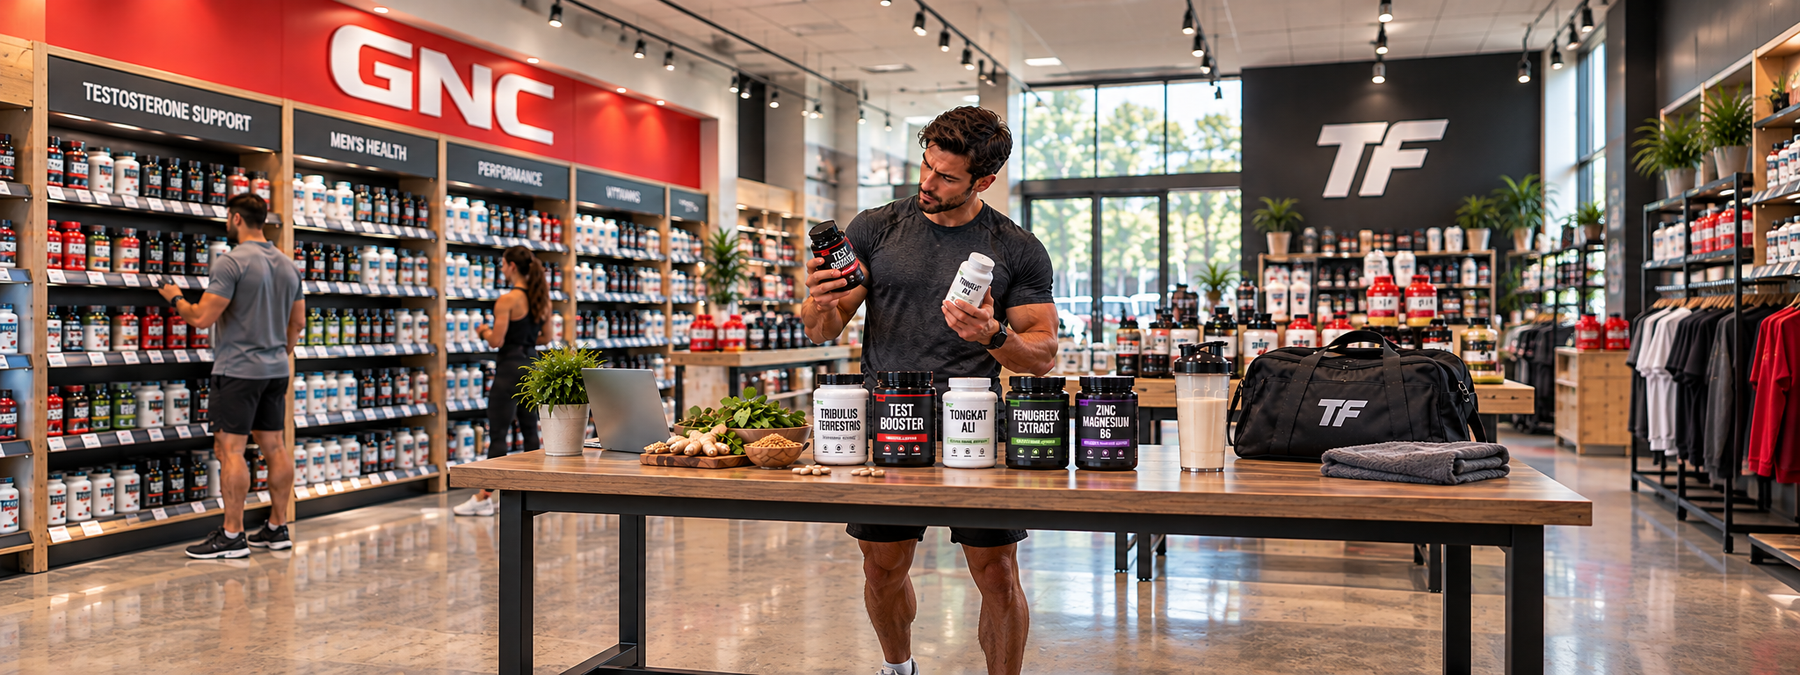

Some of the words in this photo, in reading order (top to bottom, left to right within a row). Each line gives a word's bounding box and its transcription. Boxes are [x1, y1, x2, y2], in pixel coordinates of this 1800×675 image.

[330, 25, 555, 144] GNC
[83, 82, 190, 120] TESTOSTERONE
[192, 105, 252, 132] SUPPORT
[330, 131, 364, 153] MEN'S
[366, 139, 407, 161] HEALTH
[1317, 118, 1449, 198] TF
[478, 160, 543, 187] PERFORMANCE
[820, 408, 858, 419] TRIBULUS
[888, 403, 914, 417] TEST
[950, 409, 988, 421] TONGKAT
[1013, 409, 1060, 422] FENUGREEK
[1095, 404, 1117, 416] ZINC
[1317, 398, 1368, 427] TF
[880, 417, 924, 431] BOOSTER
[961, 421, 976, 433] ALI
[1018, 421, 1055, 434] EXTRACT
[1099, 428, 1112, 439] B6
